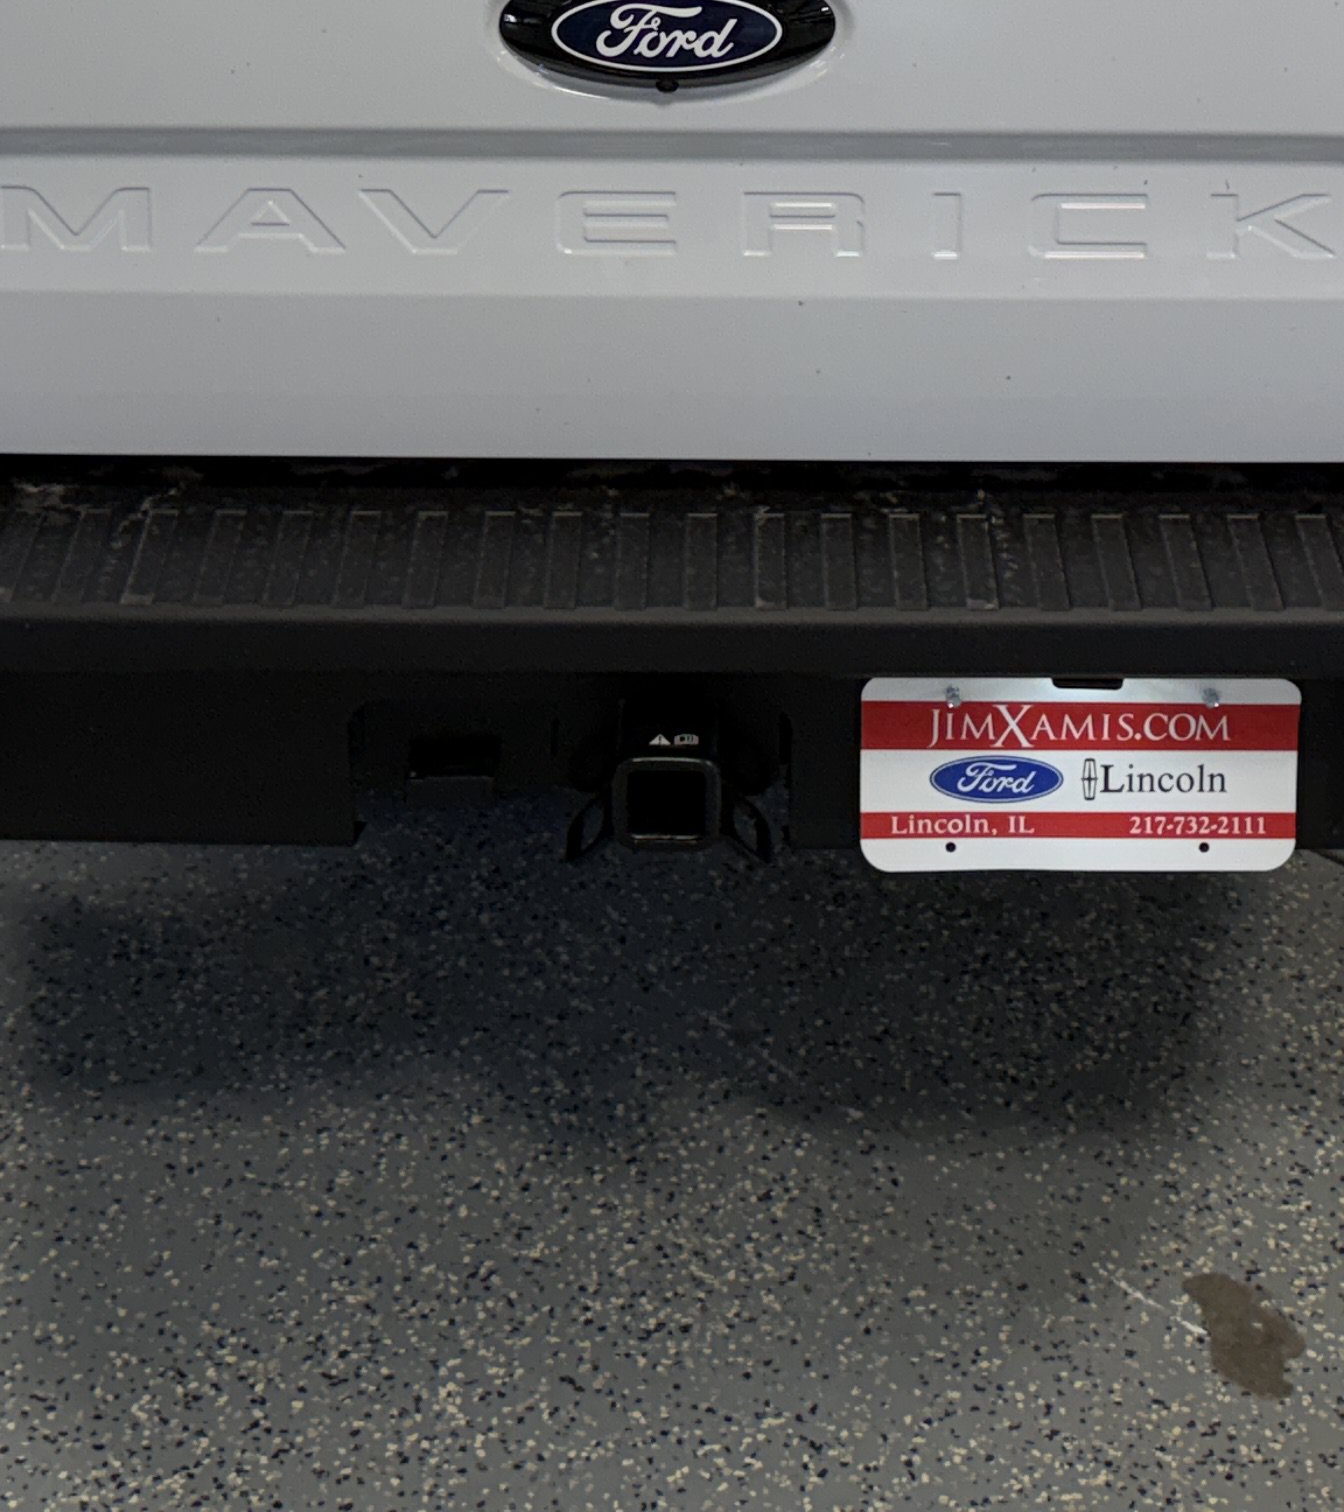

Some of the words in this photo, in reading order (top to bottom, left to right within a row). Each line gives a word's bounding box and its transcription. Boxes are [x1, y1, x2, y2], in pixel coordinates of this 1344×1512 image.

[596, 3, 738, 58] Ford
[0, 187, 1338, 260] MAVERICK
[927, 705, 1231, 748] JIMXAMIS.COM
[957, 762, 1035, 796] Ford
[1100, 764, 1227, 794] Lincoln
[891, 814, 997, 837] Lincoln,
[1008, 816, 1035, 834] IL
[1129, 816, 1267, 835] 217-732-2111
